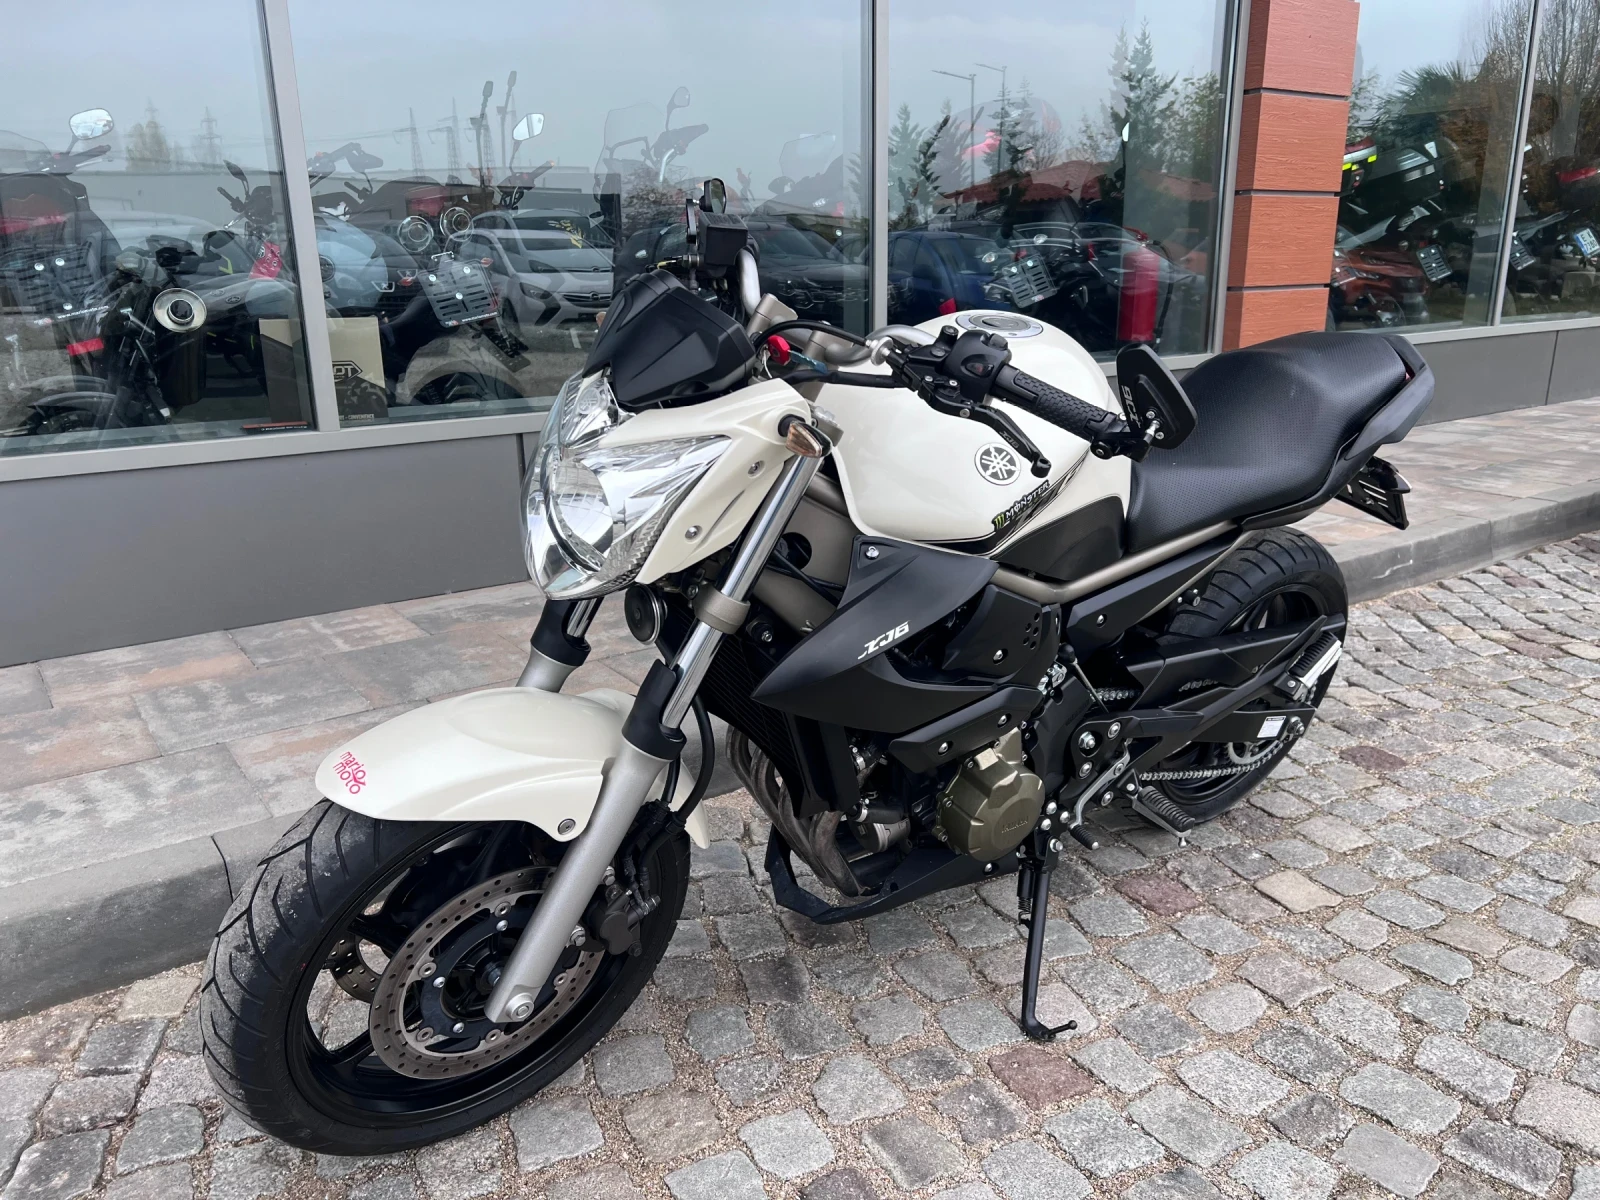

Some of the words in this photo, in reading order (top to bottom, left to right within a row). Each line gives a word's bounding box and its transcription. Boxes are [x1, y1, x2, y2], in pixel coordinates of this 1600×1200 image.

[1005, 481, 1050, 519] MONSTER
[857, 619, 911, 660] XJ6
[333, 762, 362, 795] moto
[340, 751, 366, 780] mario
